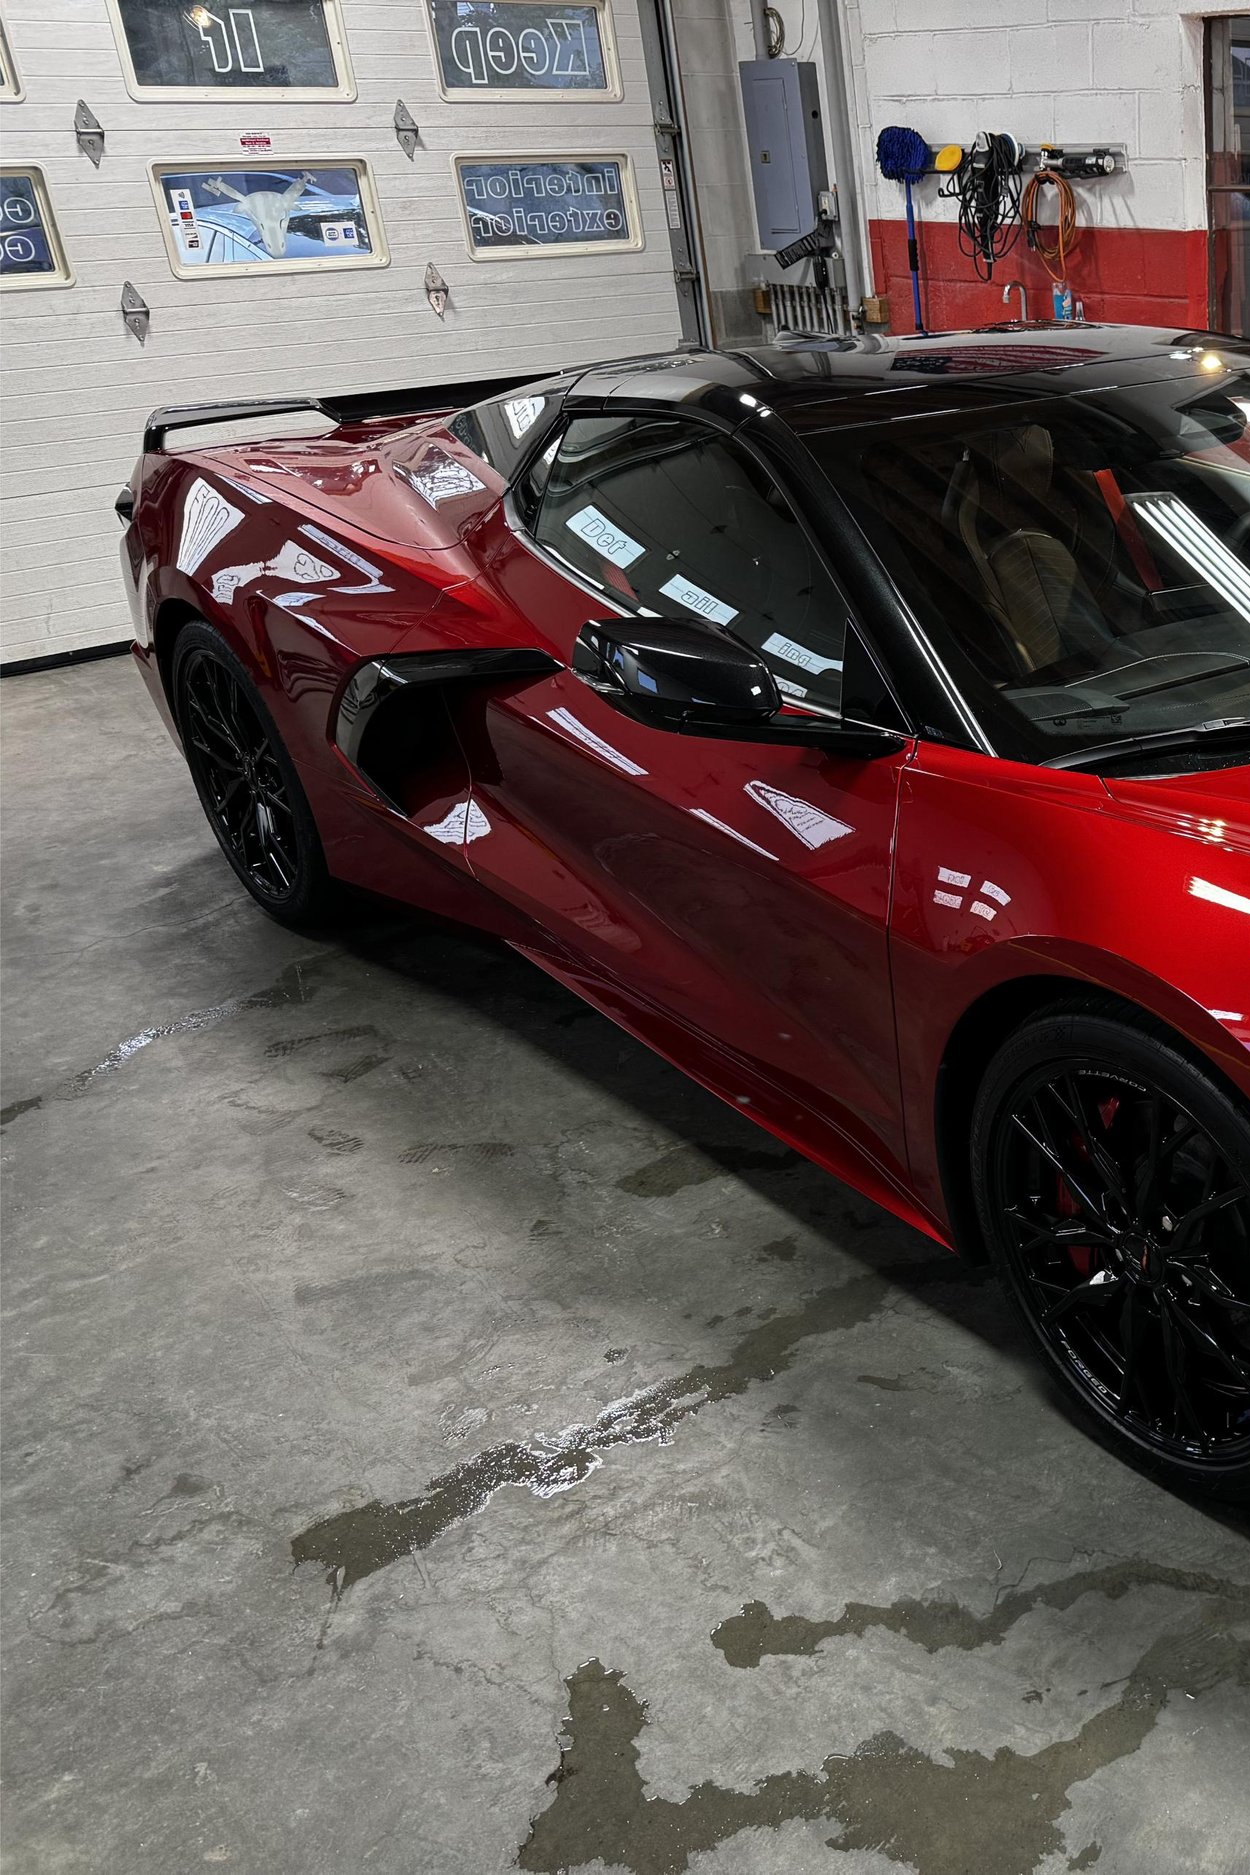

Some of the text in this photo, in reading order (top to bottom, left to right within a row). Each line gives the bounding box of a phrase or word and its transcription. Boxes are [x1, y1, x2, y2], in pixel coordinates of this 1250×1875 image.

[580, 518, 812, 668] Det ail ing
[1078, 1069, 1147, 1092] CORVETTE
[1060, 1340, 1108, 1394] FORGED
